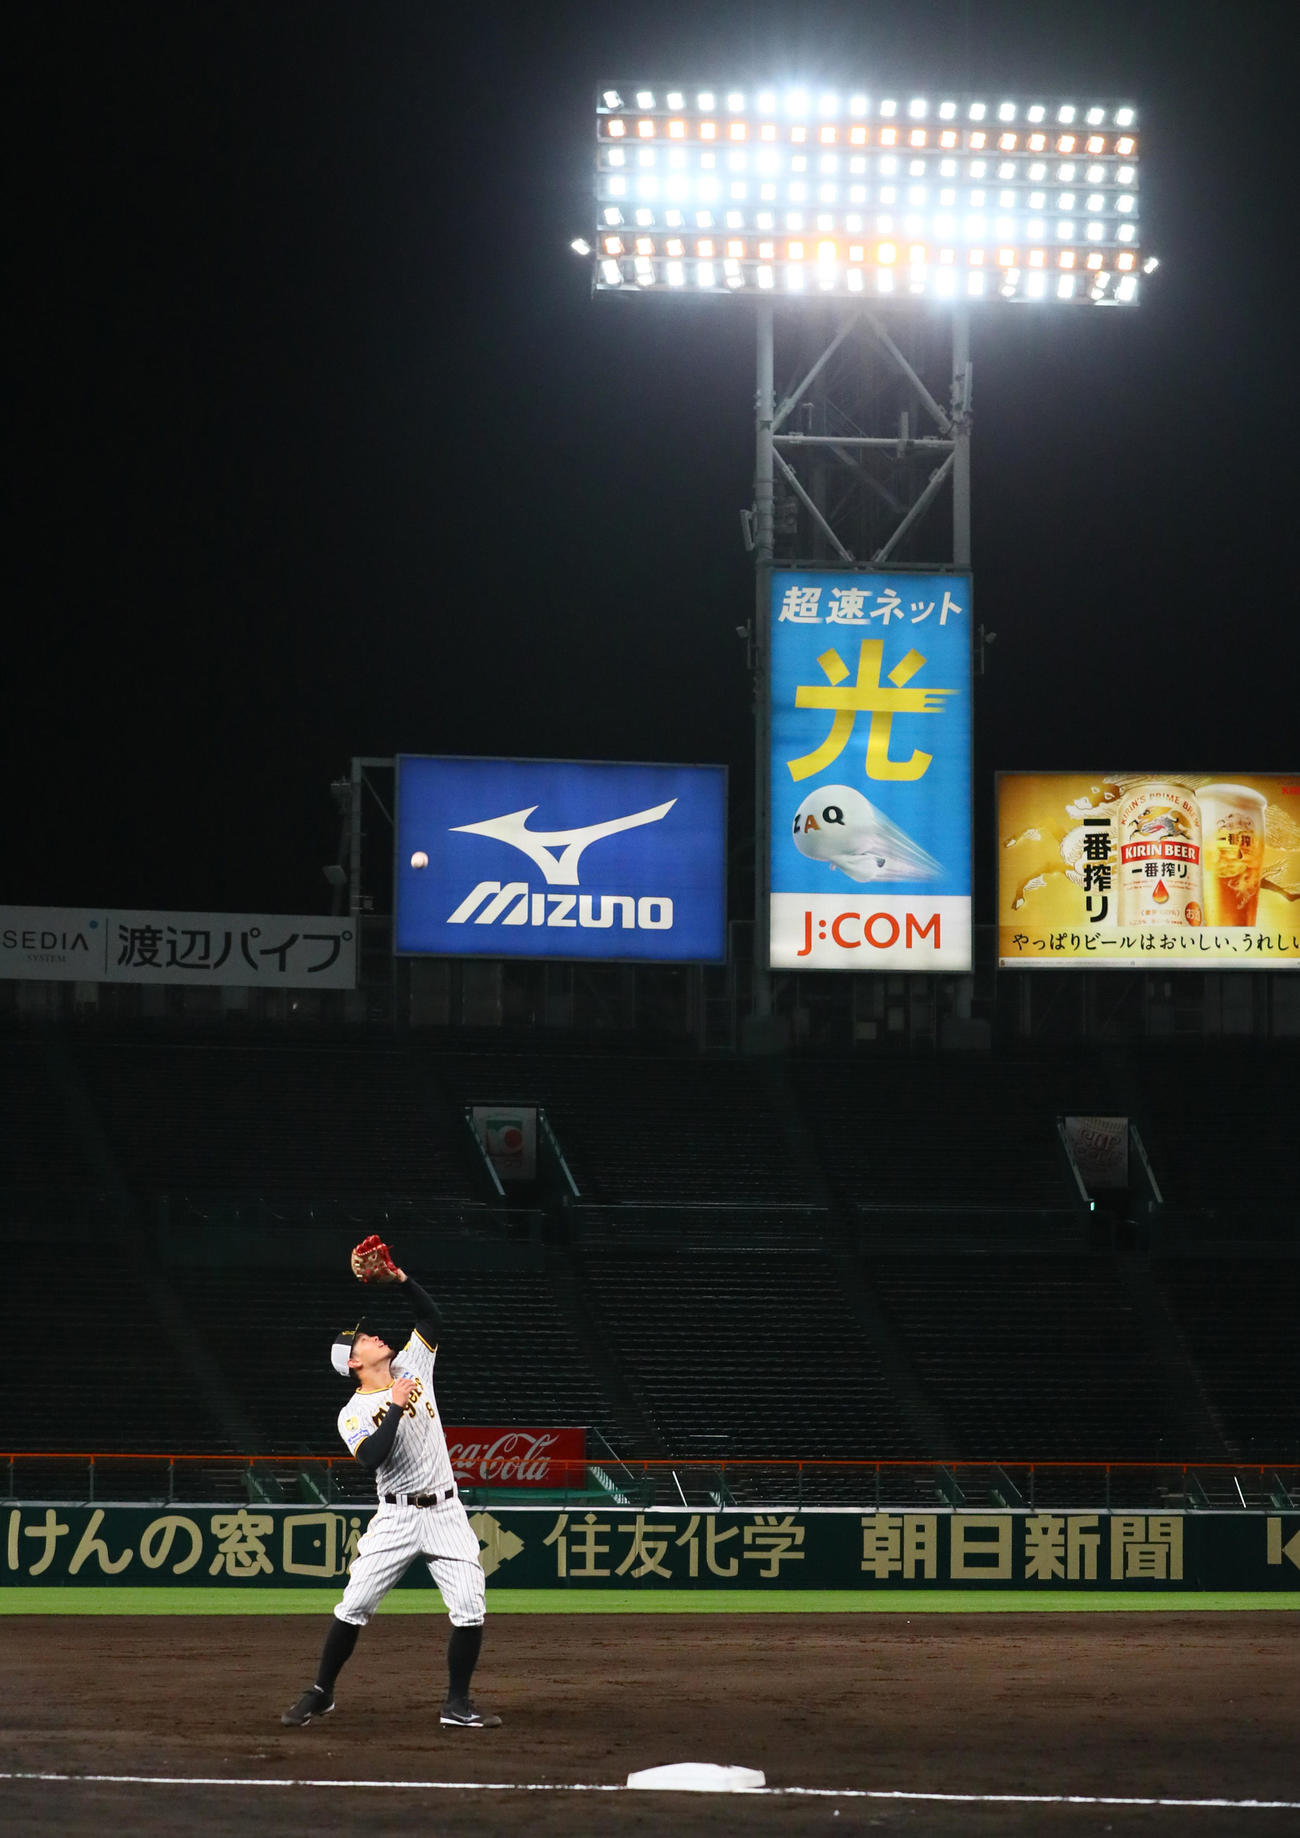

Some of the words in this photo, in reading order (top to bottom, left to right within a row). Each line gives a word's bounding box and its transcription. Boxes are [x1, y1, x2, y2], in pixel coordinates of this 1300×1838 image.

[778, 586, 963, 626] 超速ネット
[787, 638, 961, 783] 光
[1083, 818, 1111, 923] 一番搾り
[1125, 844, 1162, 859] KIRIN
[1165, 844, 1196, 860] BEER
[1132, 862, 1188, 878] 一番搾り
[118, 924, 353, 973] 渡辺パイプ
[797, 911, 941, 956] J:COM
[543, 1513, 805, 1579] 住友化学
[861, 1513, 1183, 1580] 朝日新聞
